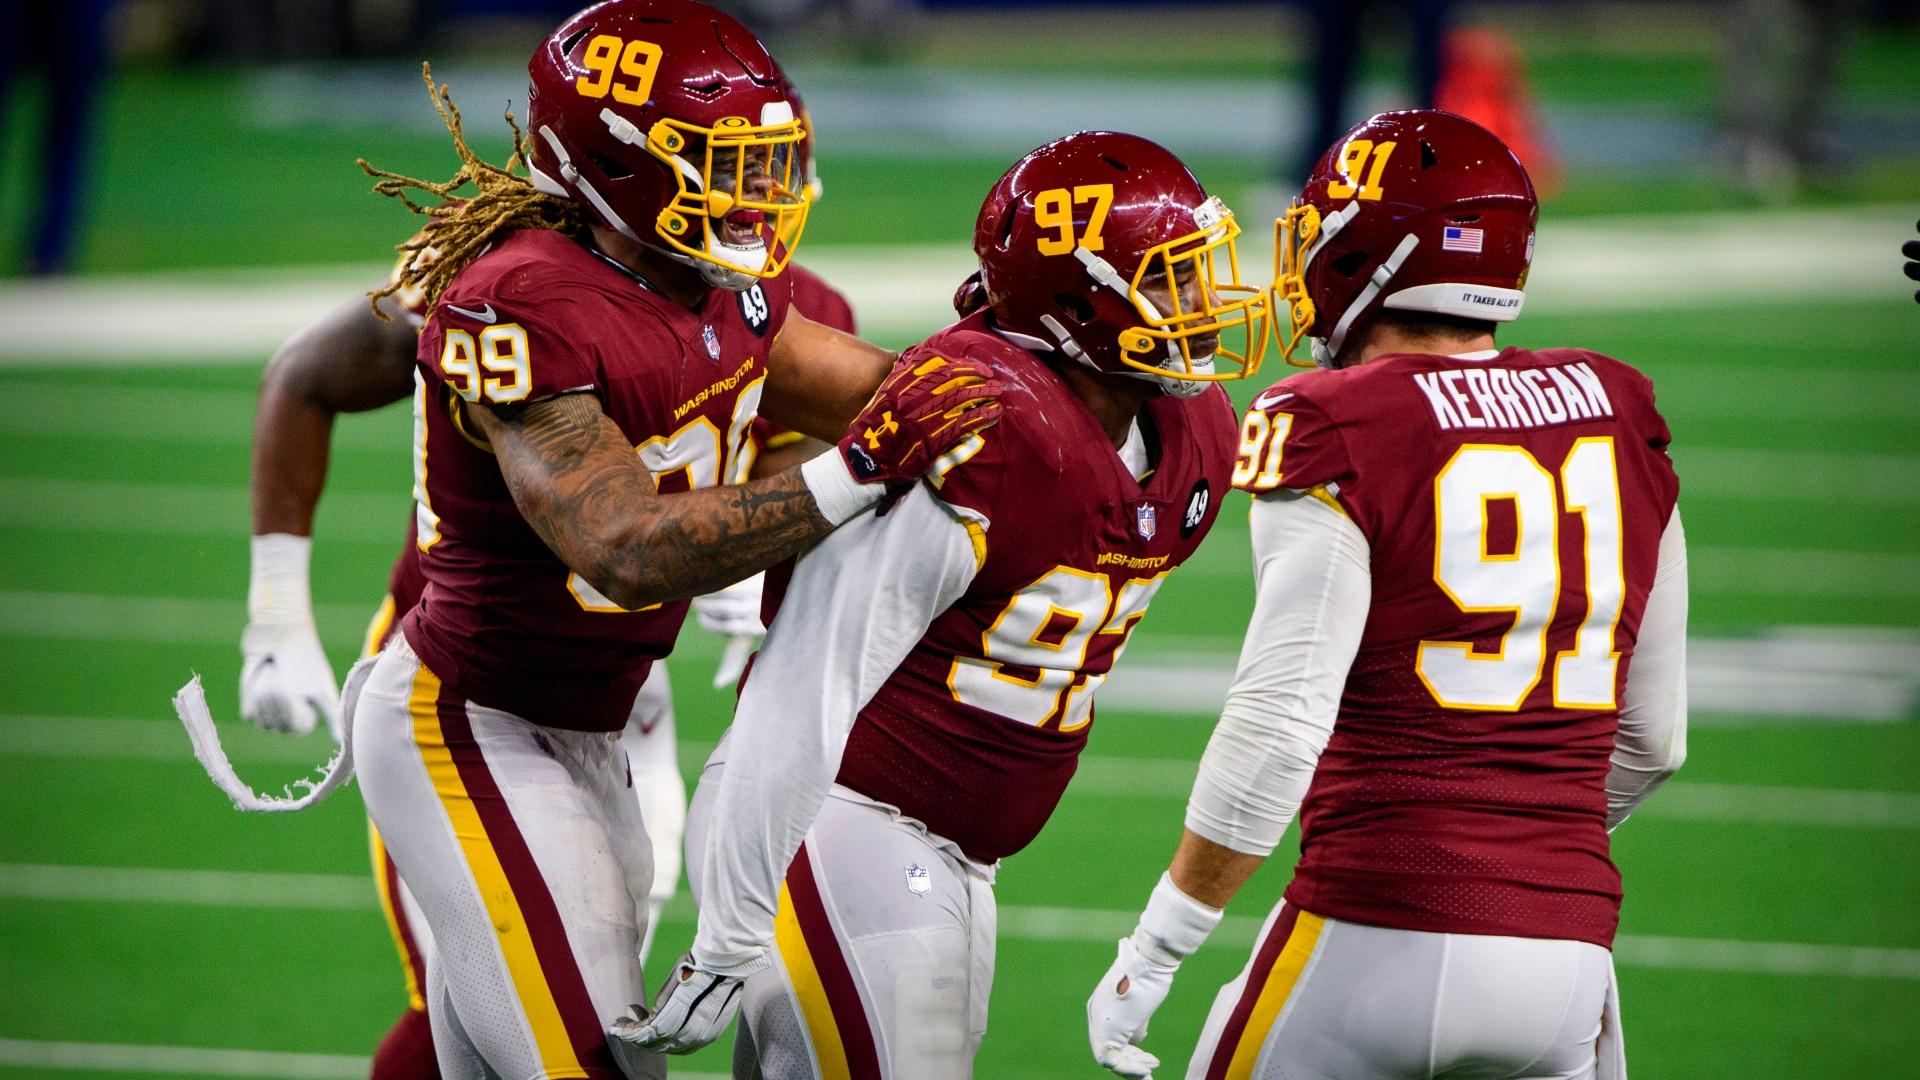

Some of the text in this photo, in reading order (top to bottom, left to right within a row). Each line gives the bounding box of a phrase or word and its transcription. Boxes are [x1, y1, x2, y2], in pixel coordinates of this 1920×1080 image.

[575, 34, 663, 107] 99
[1327, 139, 1397, 201] 91
[1034, 183, 1114, 257] 97
[741, 284, 768, 328] 49
[1462, 293, 1472, 302] IT
[1473, 295, 1496, 306] TAKES
[440, 322, 533, 403] 99
[673, 356, 754, 421] WASHINGTON
[1413, 362, 1614, 430] KERRIGAN
[1231, 409, 1294, 489] 91
[1185, 489, 1209, 528] 49
[1096, 552, 1170, 569] WASHINGTON
[1415, 436, 1626, 712] 91
[946, 564, 1180, 732] 97
